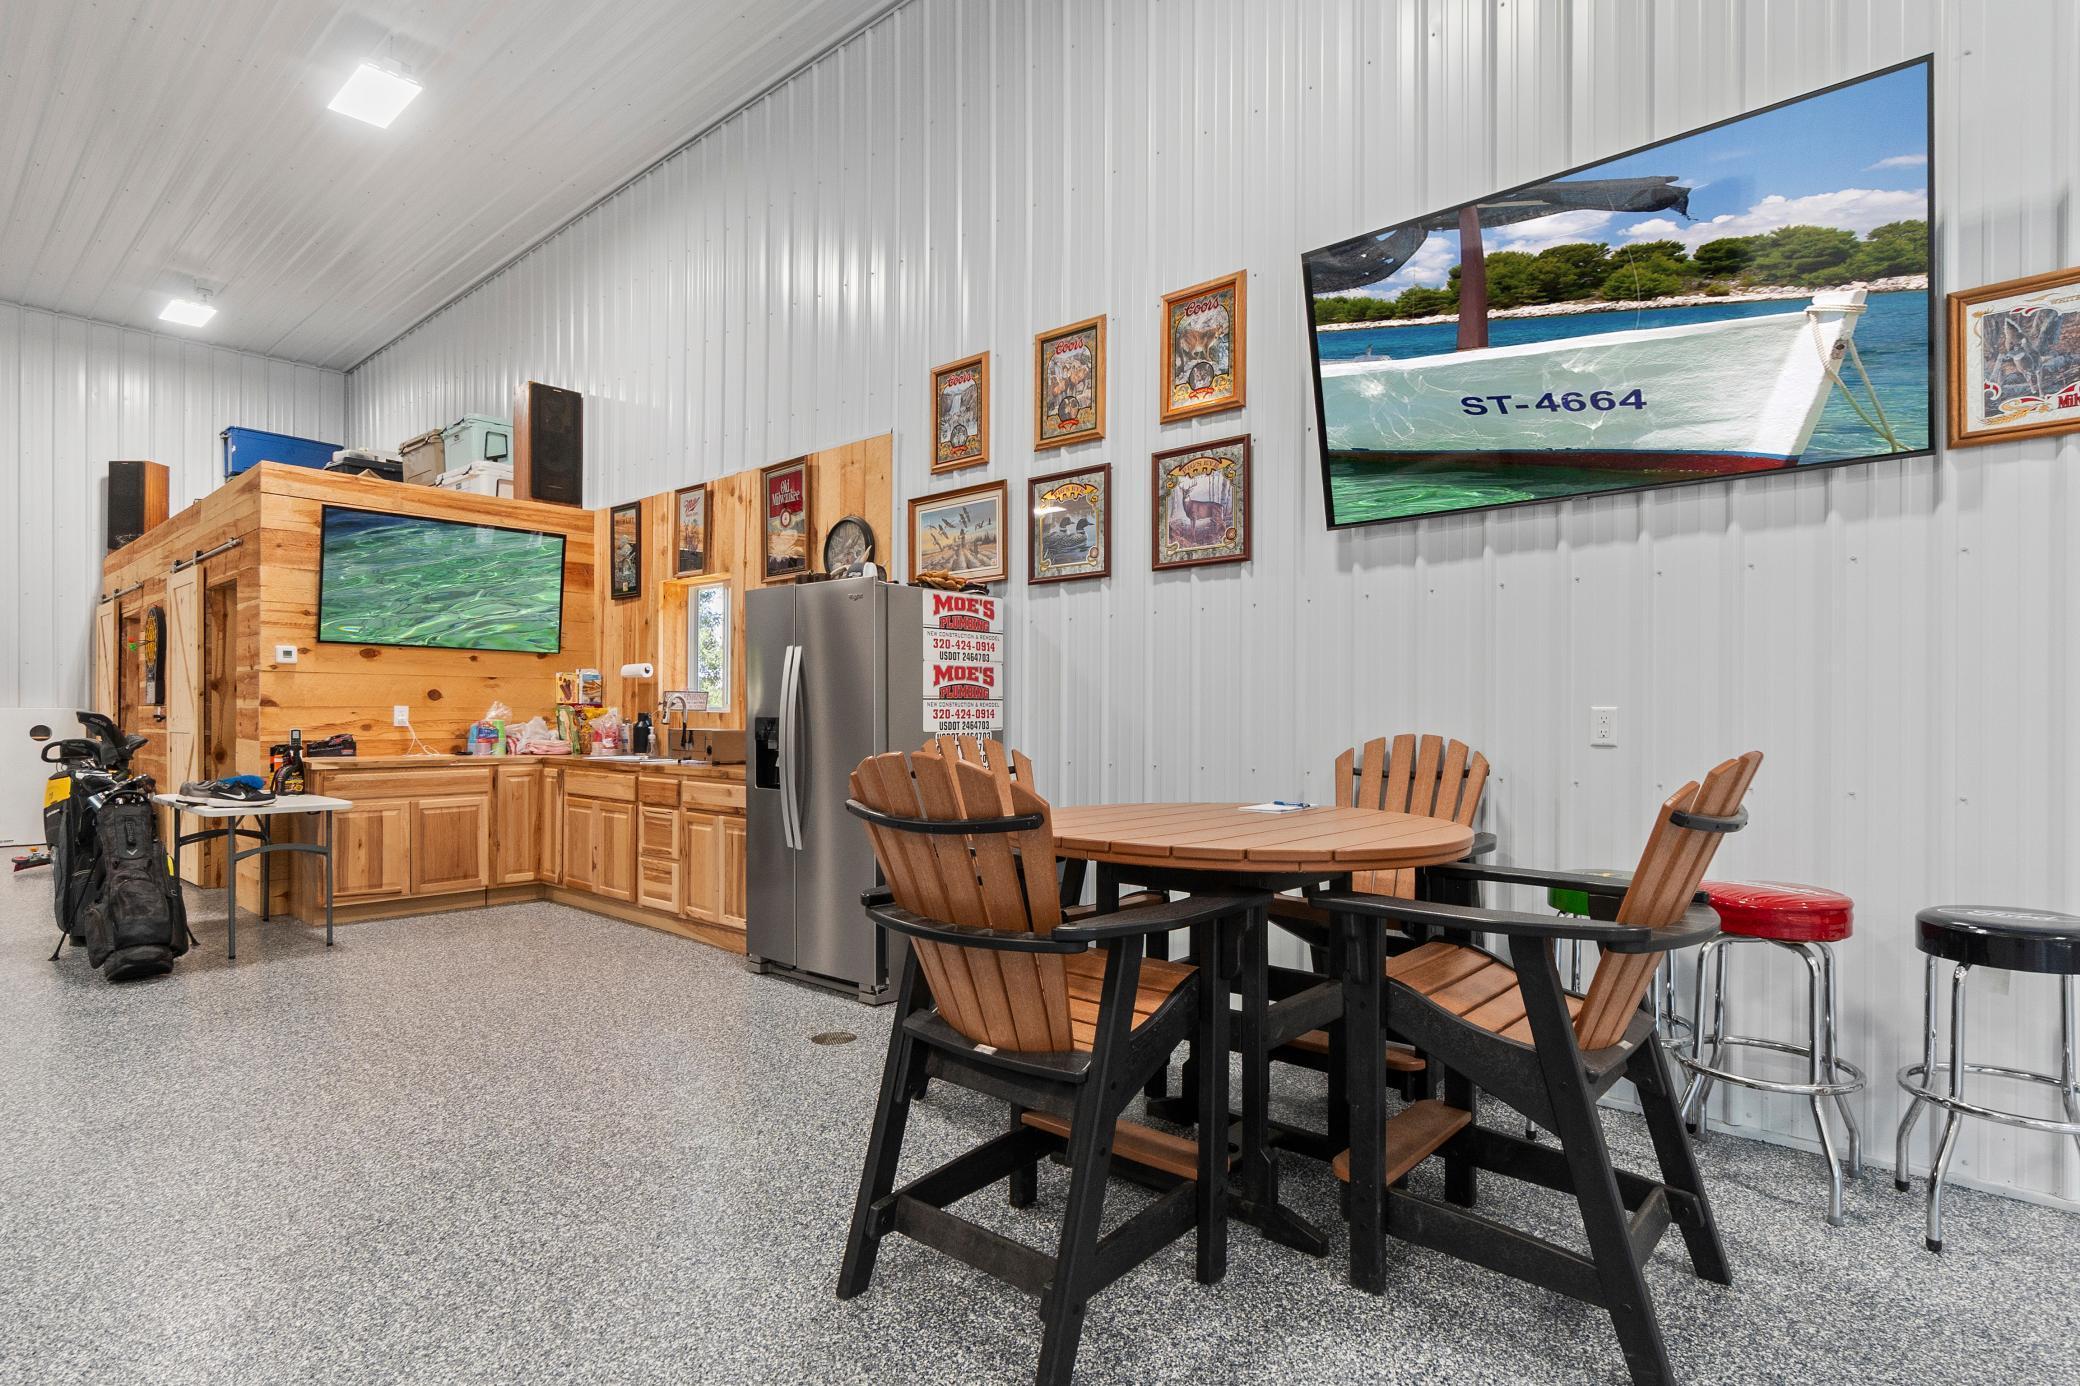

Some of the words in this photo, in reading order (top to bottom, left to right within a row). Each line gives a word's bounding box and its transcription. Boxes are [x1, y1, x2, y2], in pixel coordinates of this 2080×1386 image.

[1461, 388, 1647, 416] ST-4664
[933, 594, 995, 621] MOE'S
[940, 615, 989, 633] PLUMBING
[939, 631, 975, 639] CONSTRUCTION
[980, 634, 1000, 642] REMODEL
[933, 638, 996, 653] 320-424-0914
[939, 650, 961, 662] USDOT
[933, 664, 995, 688] MOE'S
[940, 684, 989, 699] PLUMBING
[932, 709, 995, 719] 320-424-0914
[939, 721, 961, 731] USDOT
